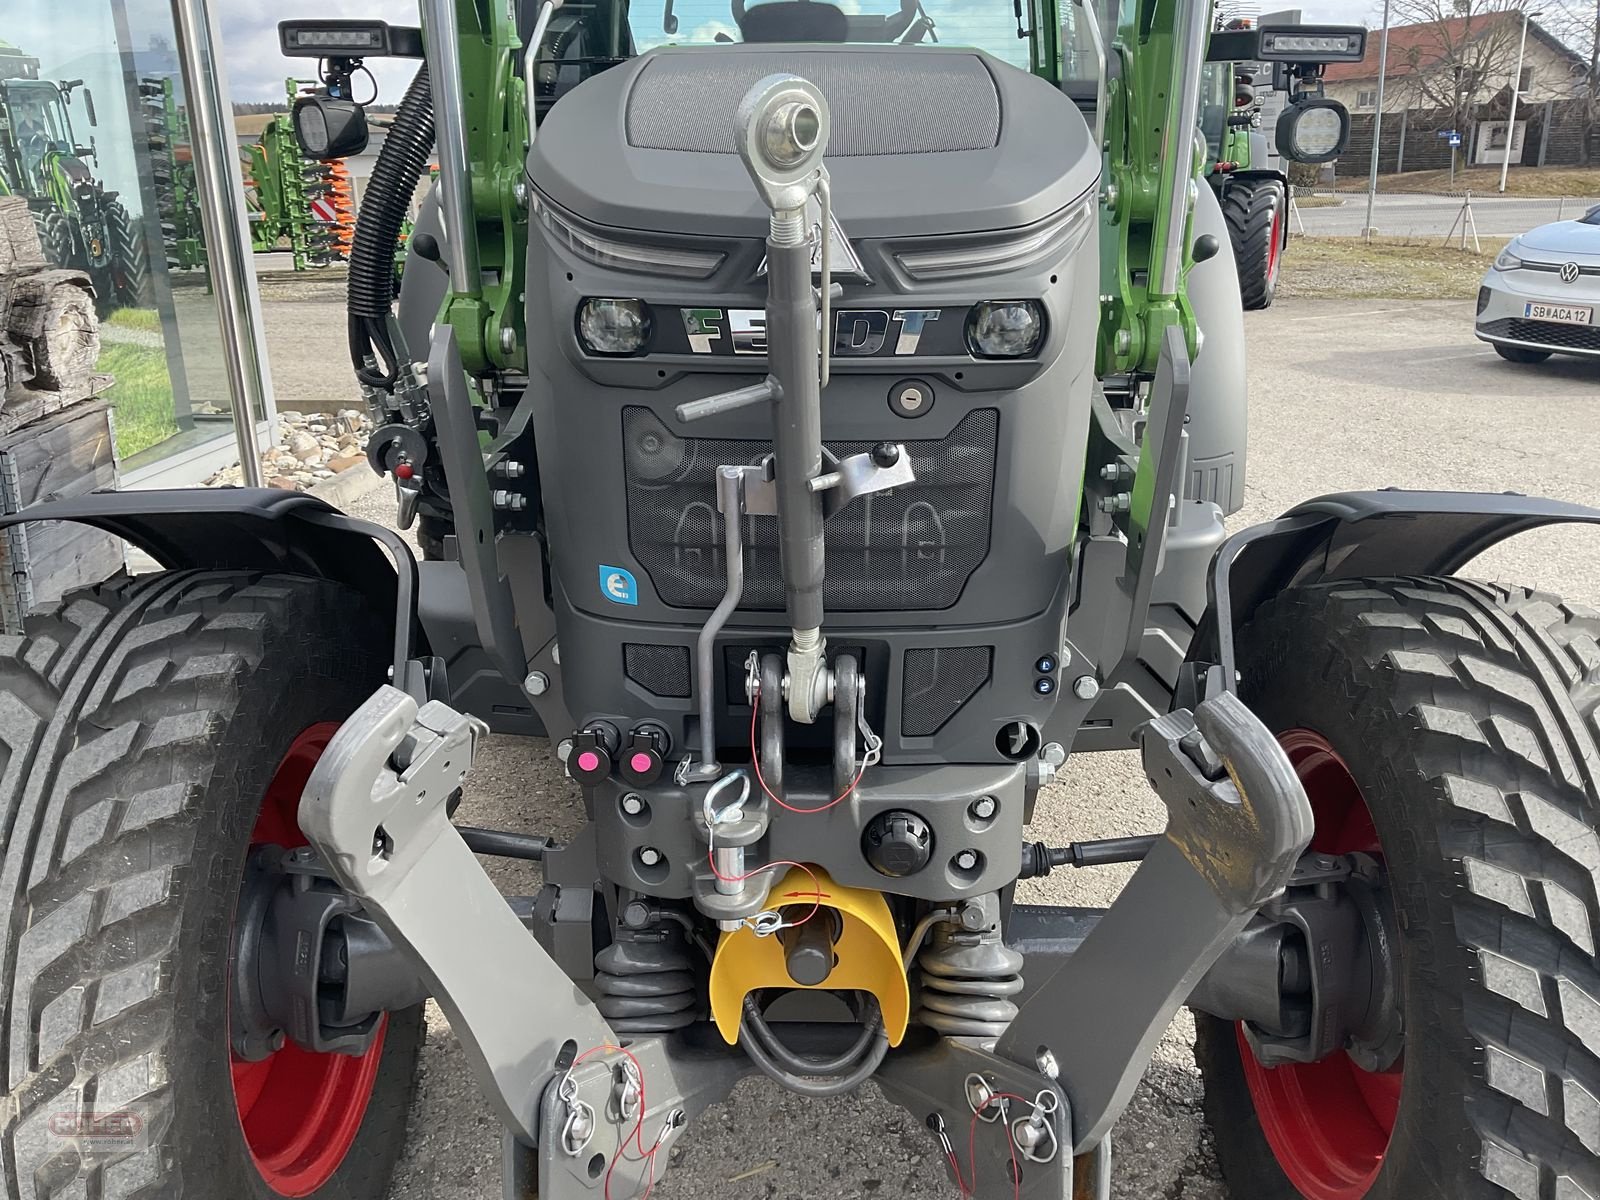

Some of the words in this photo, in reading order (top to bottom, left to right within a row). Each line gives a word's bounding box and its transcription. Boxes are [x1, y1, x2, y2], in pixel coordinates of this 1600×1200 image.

[1533, 306, 1546, 318] SB
[1551, 309, 1572, 321] ACA
[1574, 310, 1586, 322] 12
[680, 308, 941, 355] FEDT
